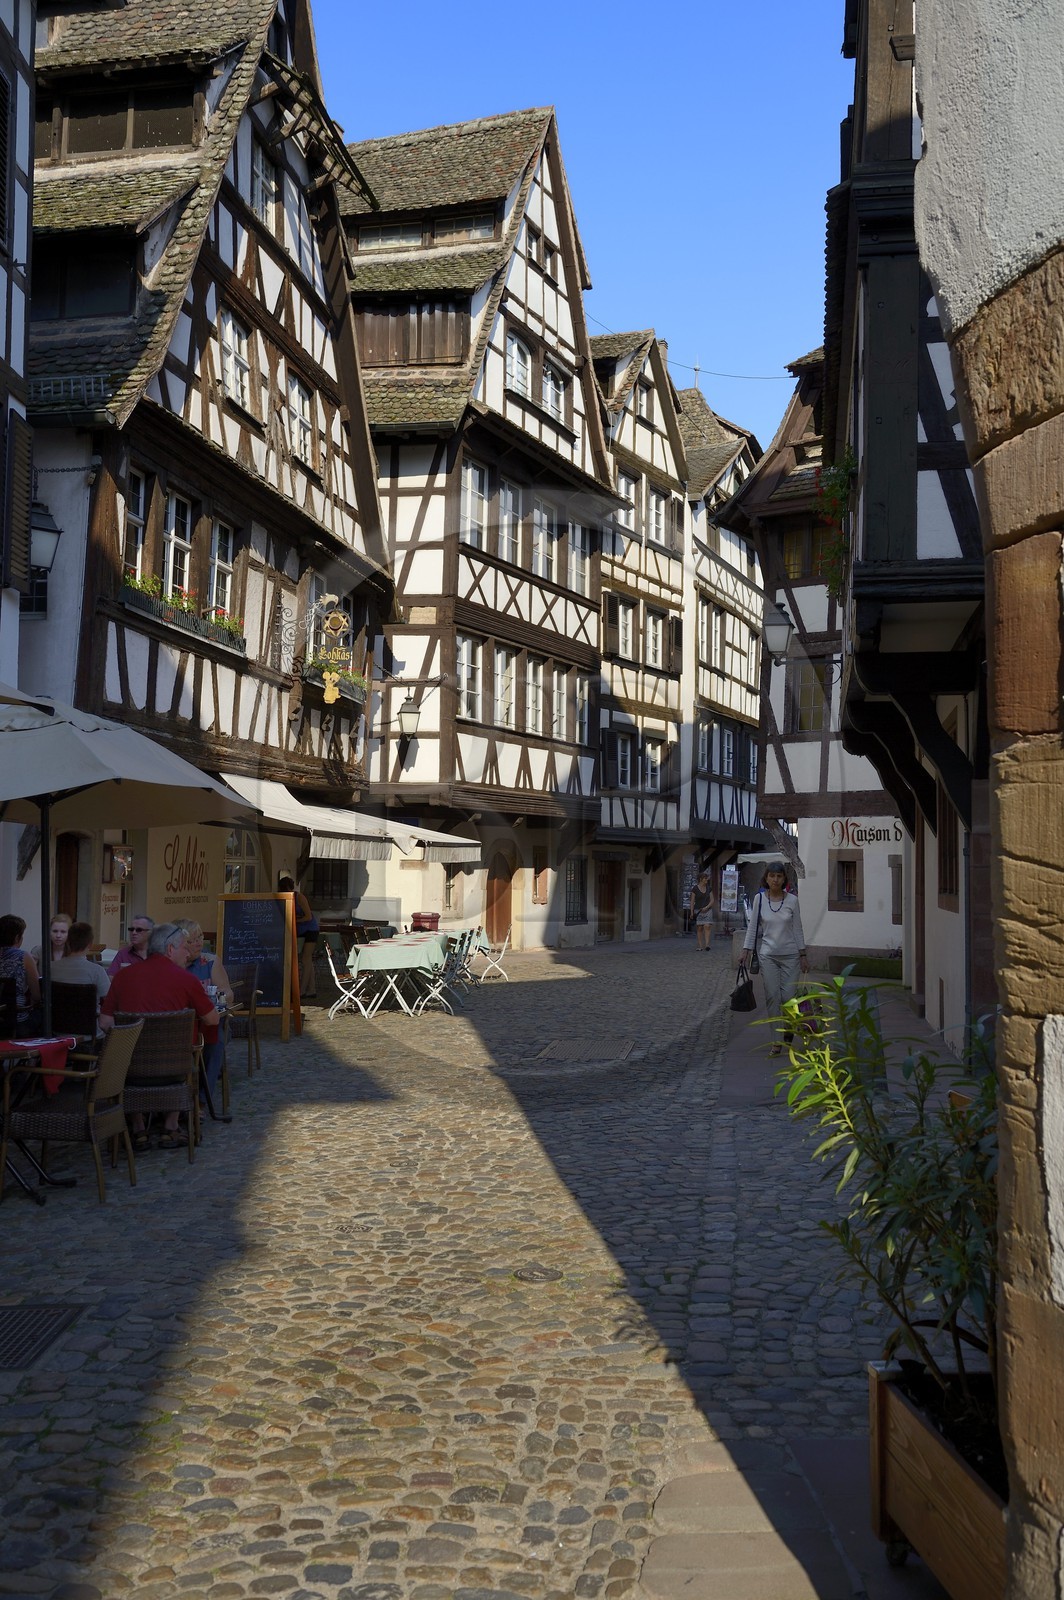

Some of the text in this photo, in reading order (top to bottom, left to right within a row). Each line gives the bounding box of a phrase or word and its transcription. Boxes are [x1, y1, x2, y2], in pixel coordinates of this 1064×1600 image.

[828, 817, 891, 847] Maison
[164, 834, 210, 893] Lohkäs
[164, 896, 186, 905] RESTAURANT
[186, 896, 192, 904] DE
